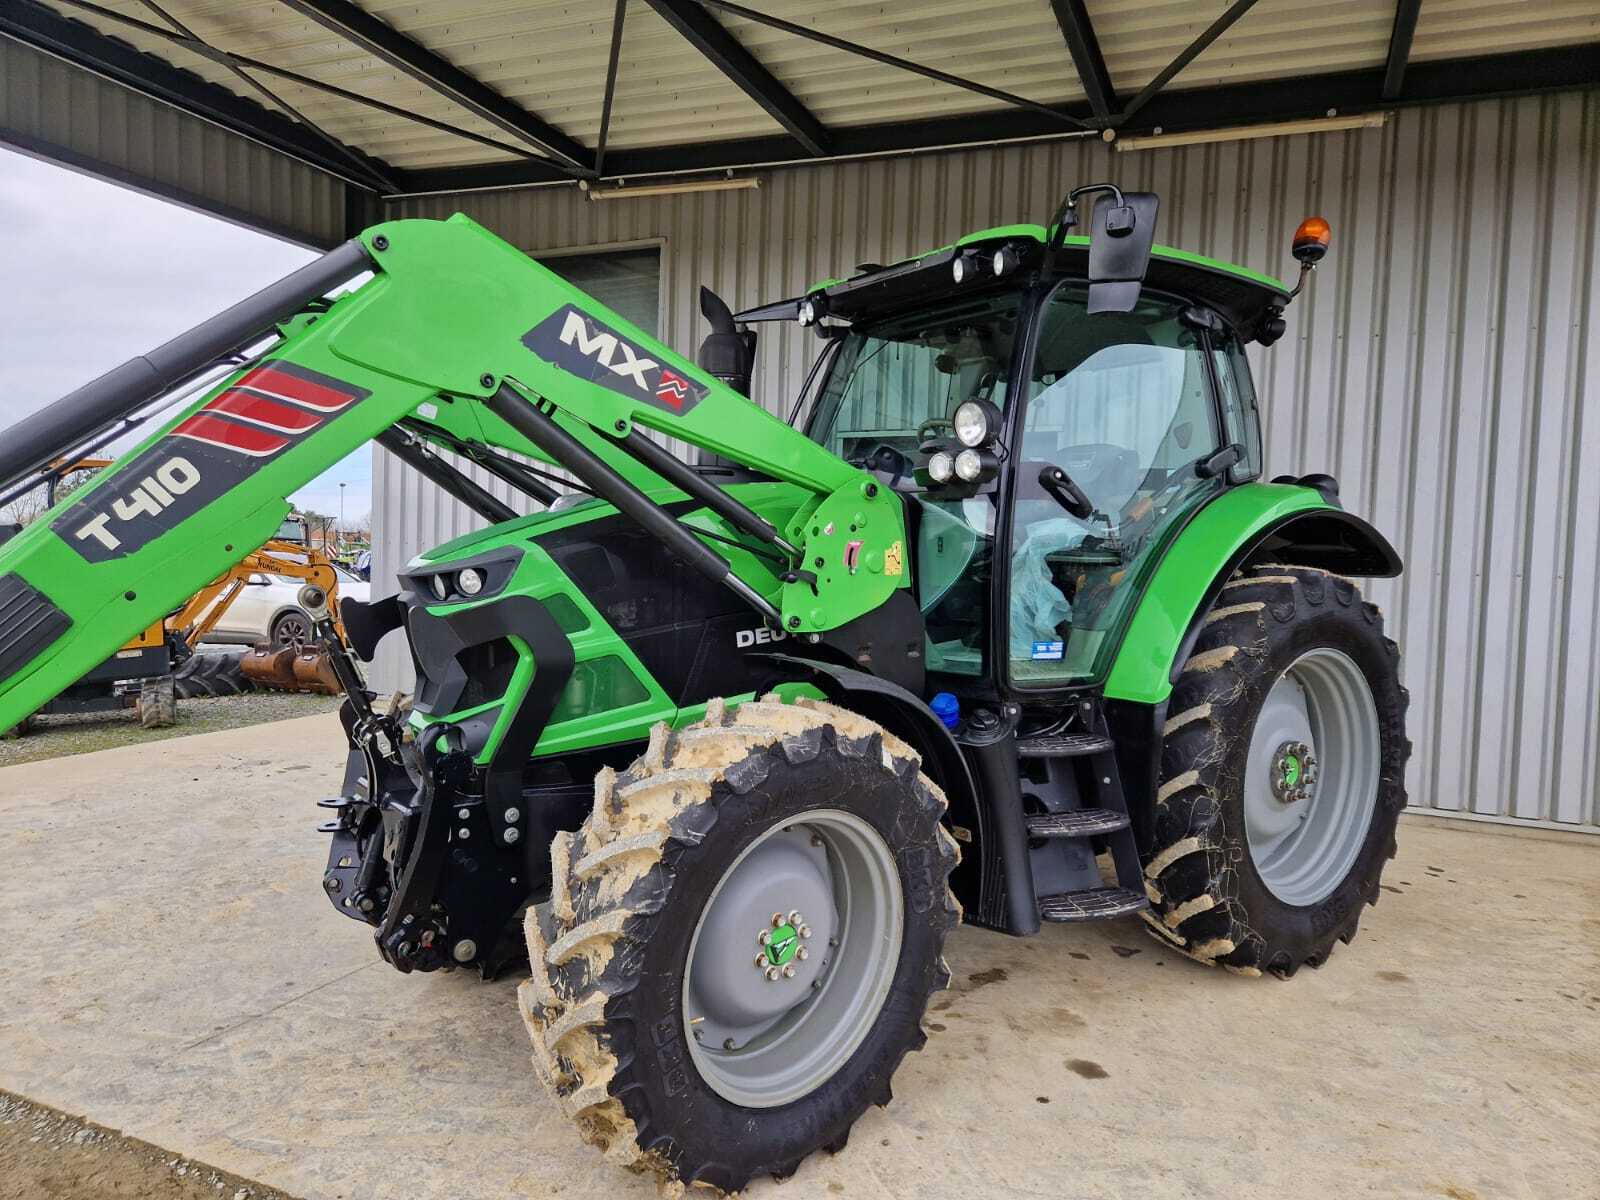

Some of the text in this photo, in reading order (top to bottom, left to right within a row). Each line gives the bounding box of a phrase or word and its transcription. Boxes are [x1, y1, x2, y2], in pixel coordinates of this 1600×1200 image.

[559, 311, 659, 392] MX
[75, 456, 201, 551] T 410
[736, 626, 797, 648] DEU
